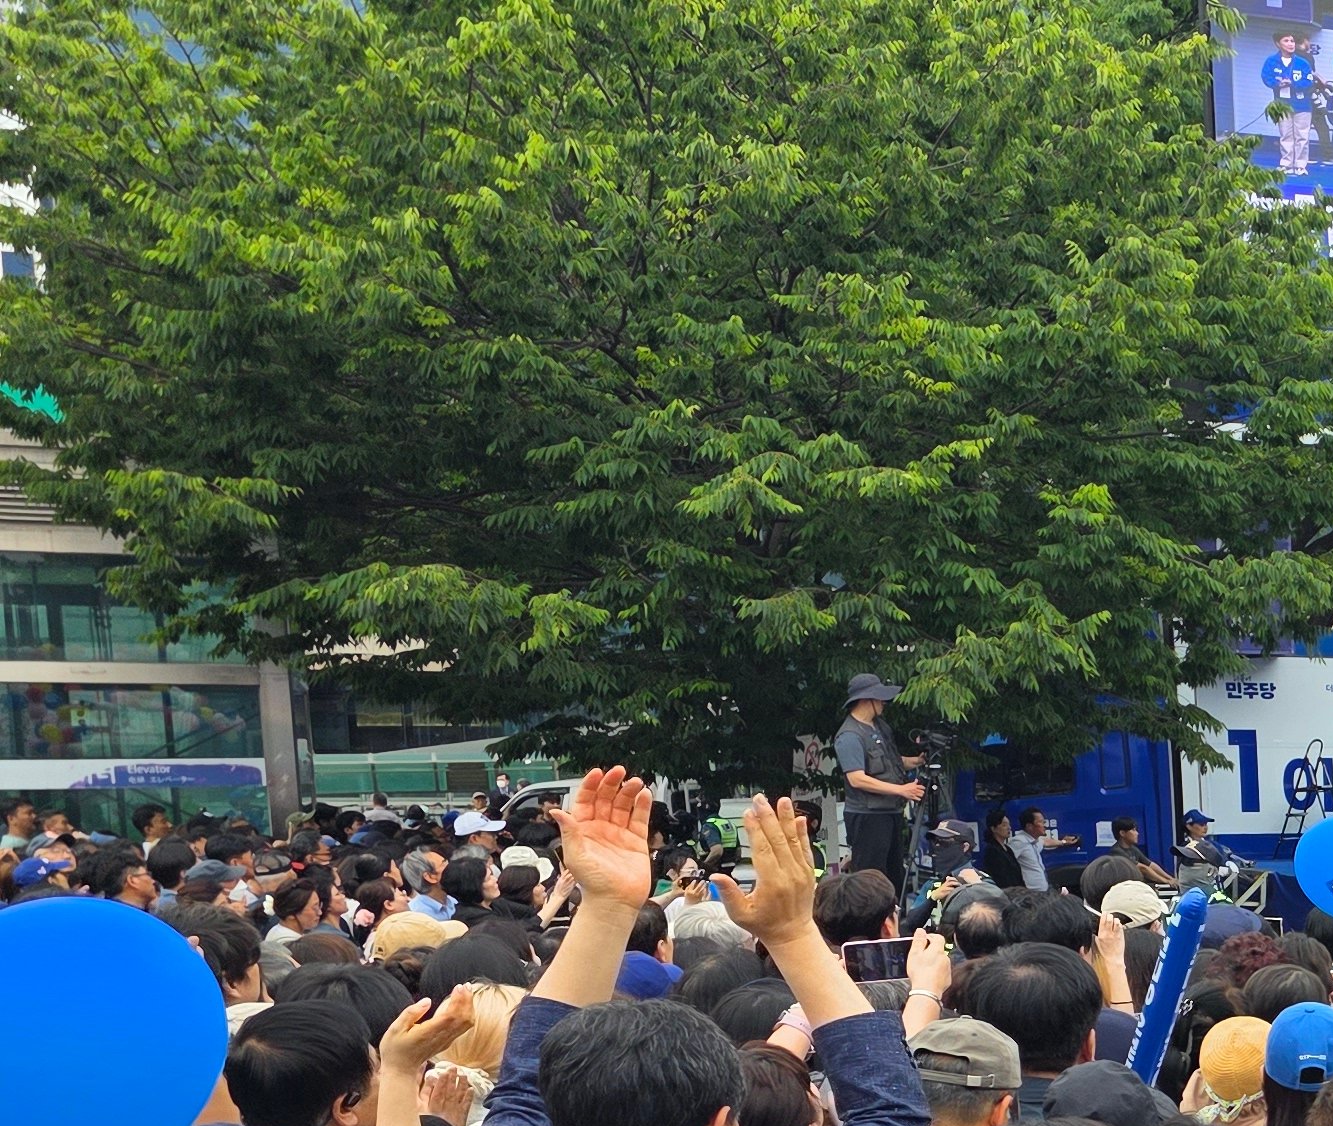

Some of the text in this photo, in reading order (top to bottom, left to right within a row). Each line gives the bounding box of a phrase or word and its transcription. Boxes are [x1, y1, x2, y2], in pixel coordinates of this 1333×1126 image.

[1225, 682, 1276, 700] 민주당
[127, 765, 171, 774] Elevator
[1227, 729, 1261, 813] 1
